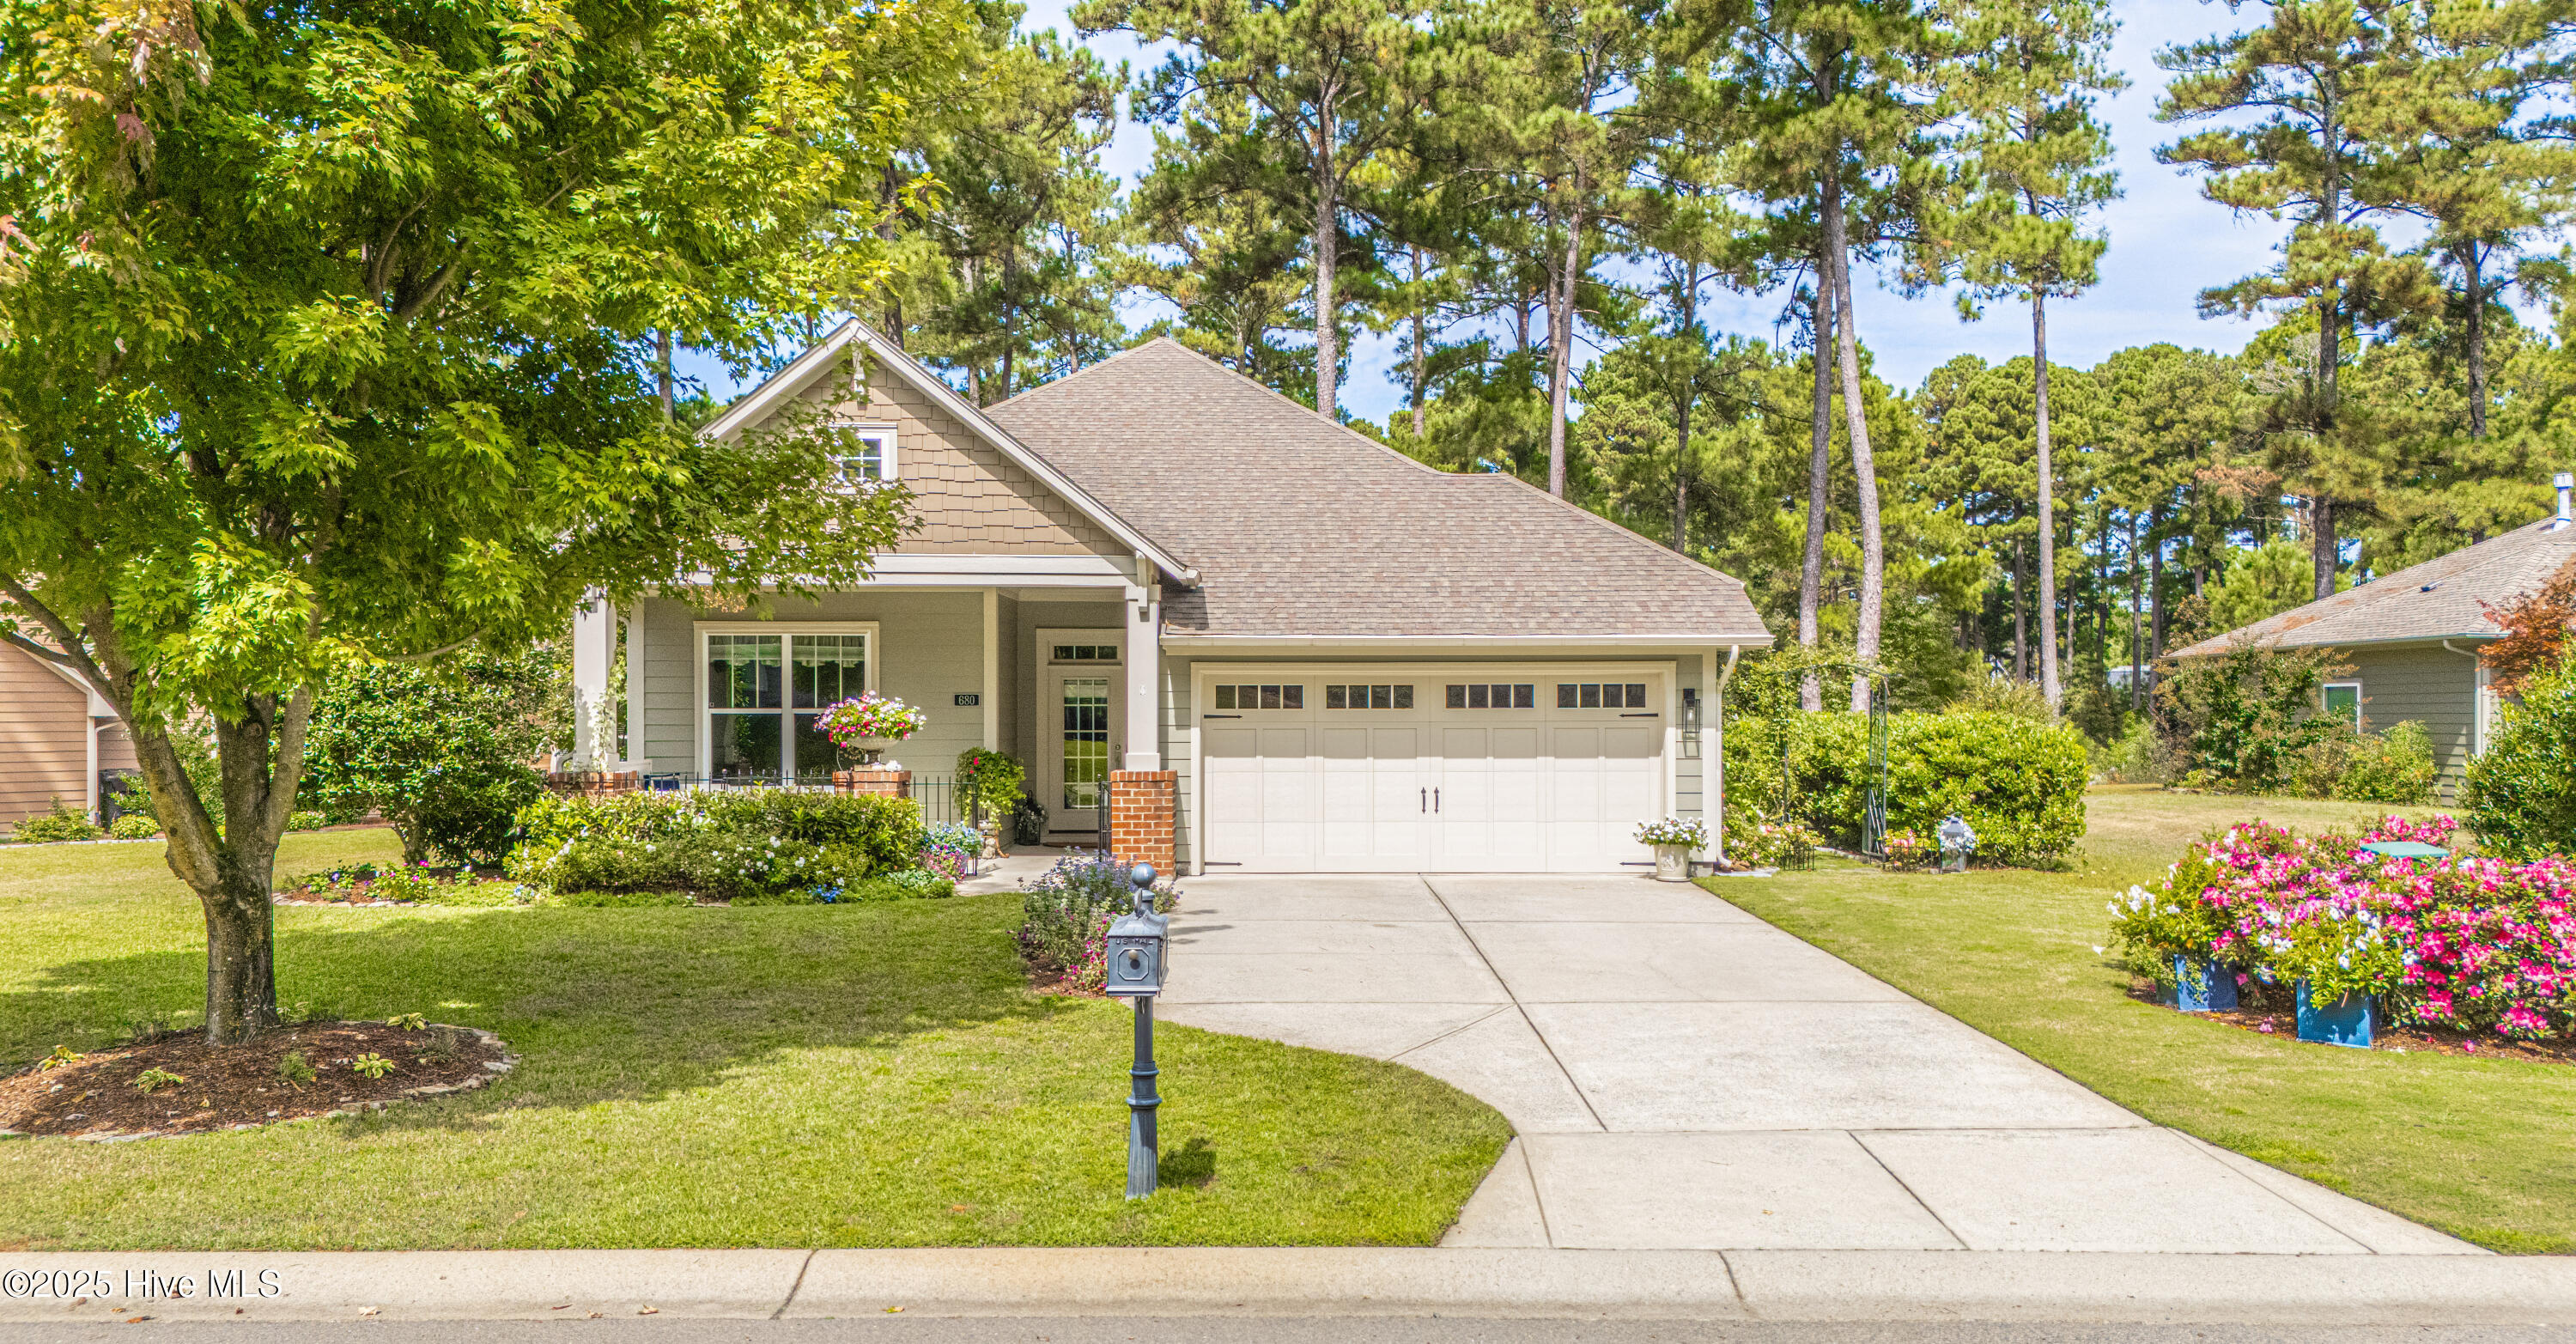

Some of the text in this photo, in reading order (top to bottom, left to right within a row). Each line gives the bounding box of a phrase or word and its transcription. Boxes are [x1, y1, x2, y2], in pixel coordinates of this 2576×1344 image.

[958, 695, 975, 705] 680
[1115, 937, 1153, 946] US MAIL
